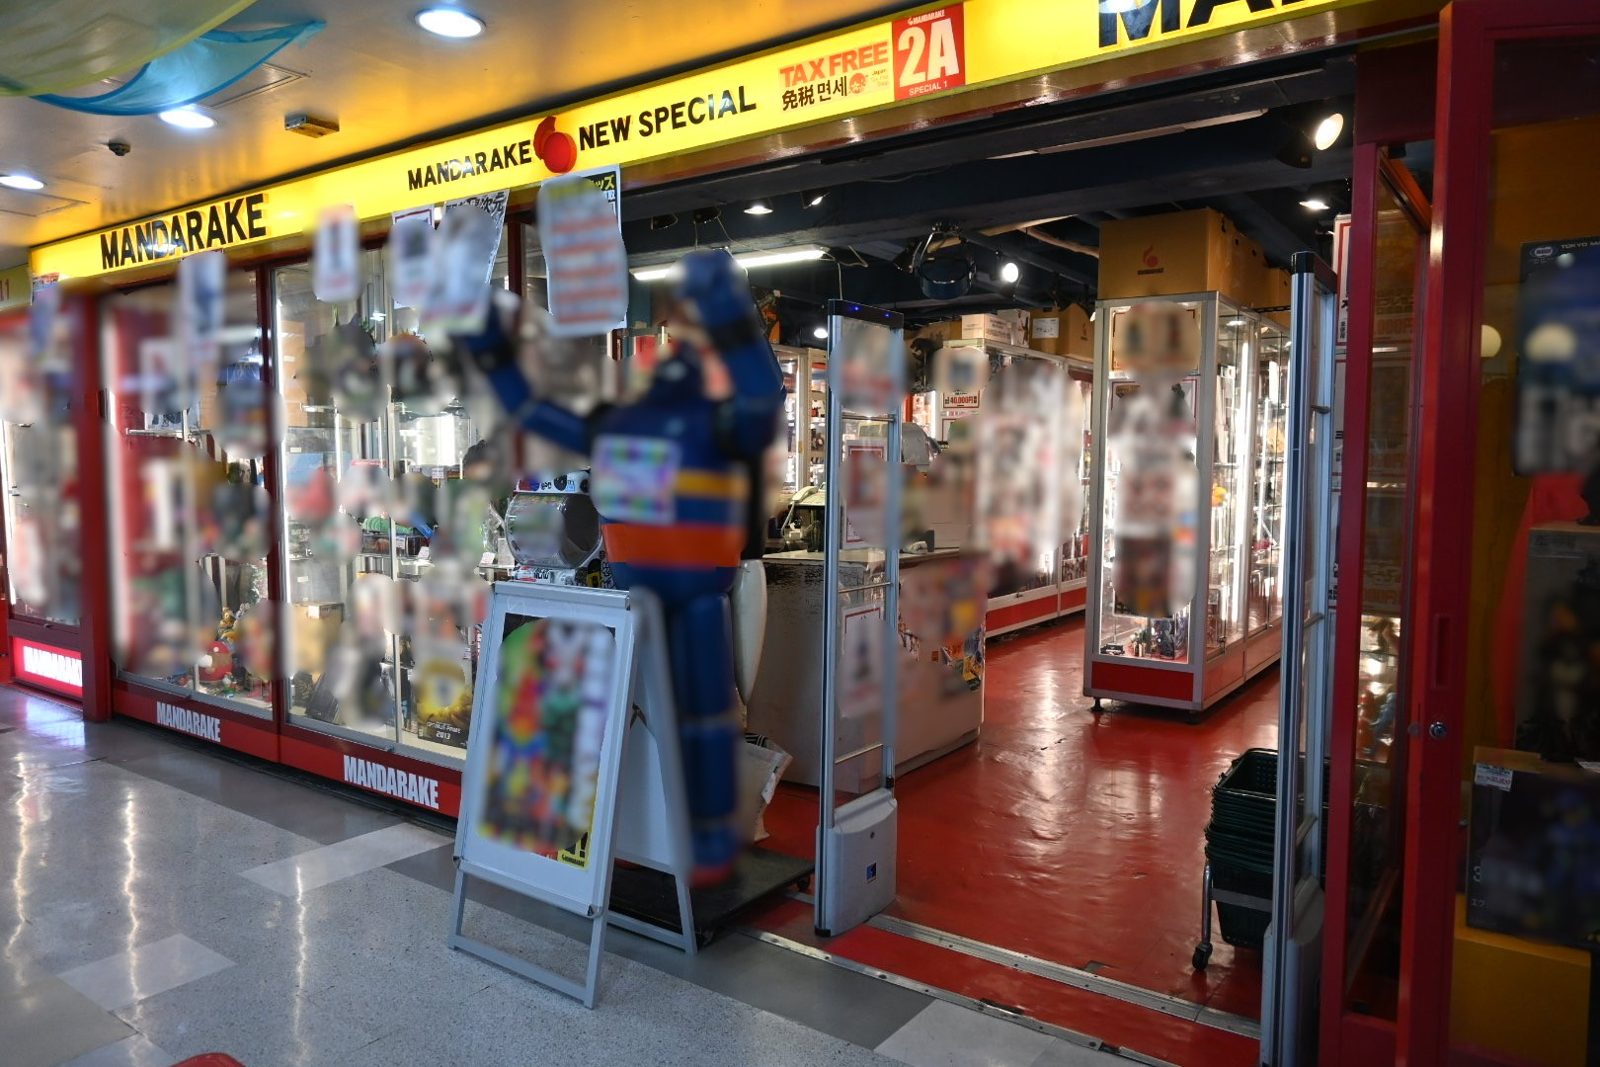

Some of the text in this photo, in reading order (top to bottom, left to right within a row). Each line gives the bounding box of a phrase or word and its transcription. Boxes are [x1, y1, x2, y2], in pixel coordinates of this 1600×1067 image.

[779, 41, 888, 88] TAX FREE
[898, 18, 960, 87] 2A
[781, 84, 815, 111] 免税
[817, 76, 847, 102] 면세
[908, 82, 942, 96] SPECIAL
[579, 86, 757, 151] NEW SPECIAL
[408, 140, 532, 190] MANDARAKE
[100, 193, 266, 270] MANDARAKE
[156, 701, 221, 743] MANDARAKE
[343, 754, 439, 809] MANDARAKE
